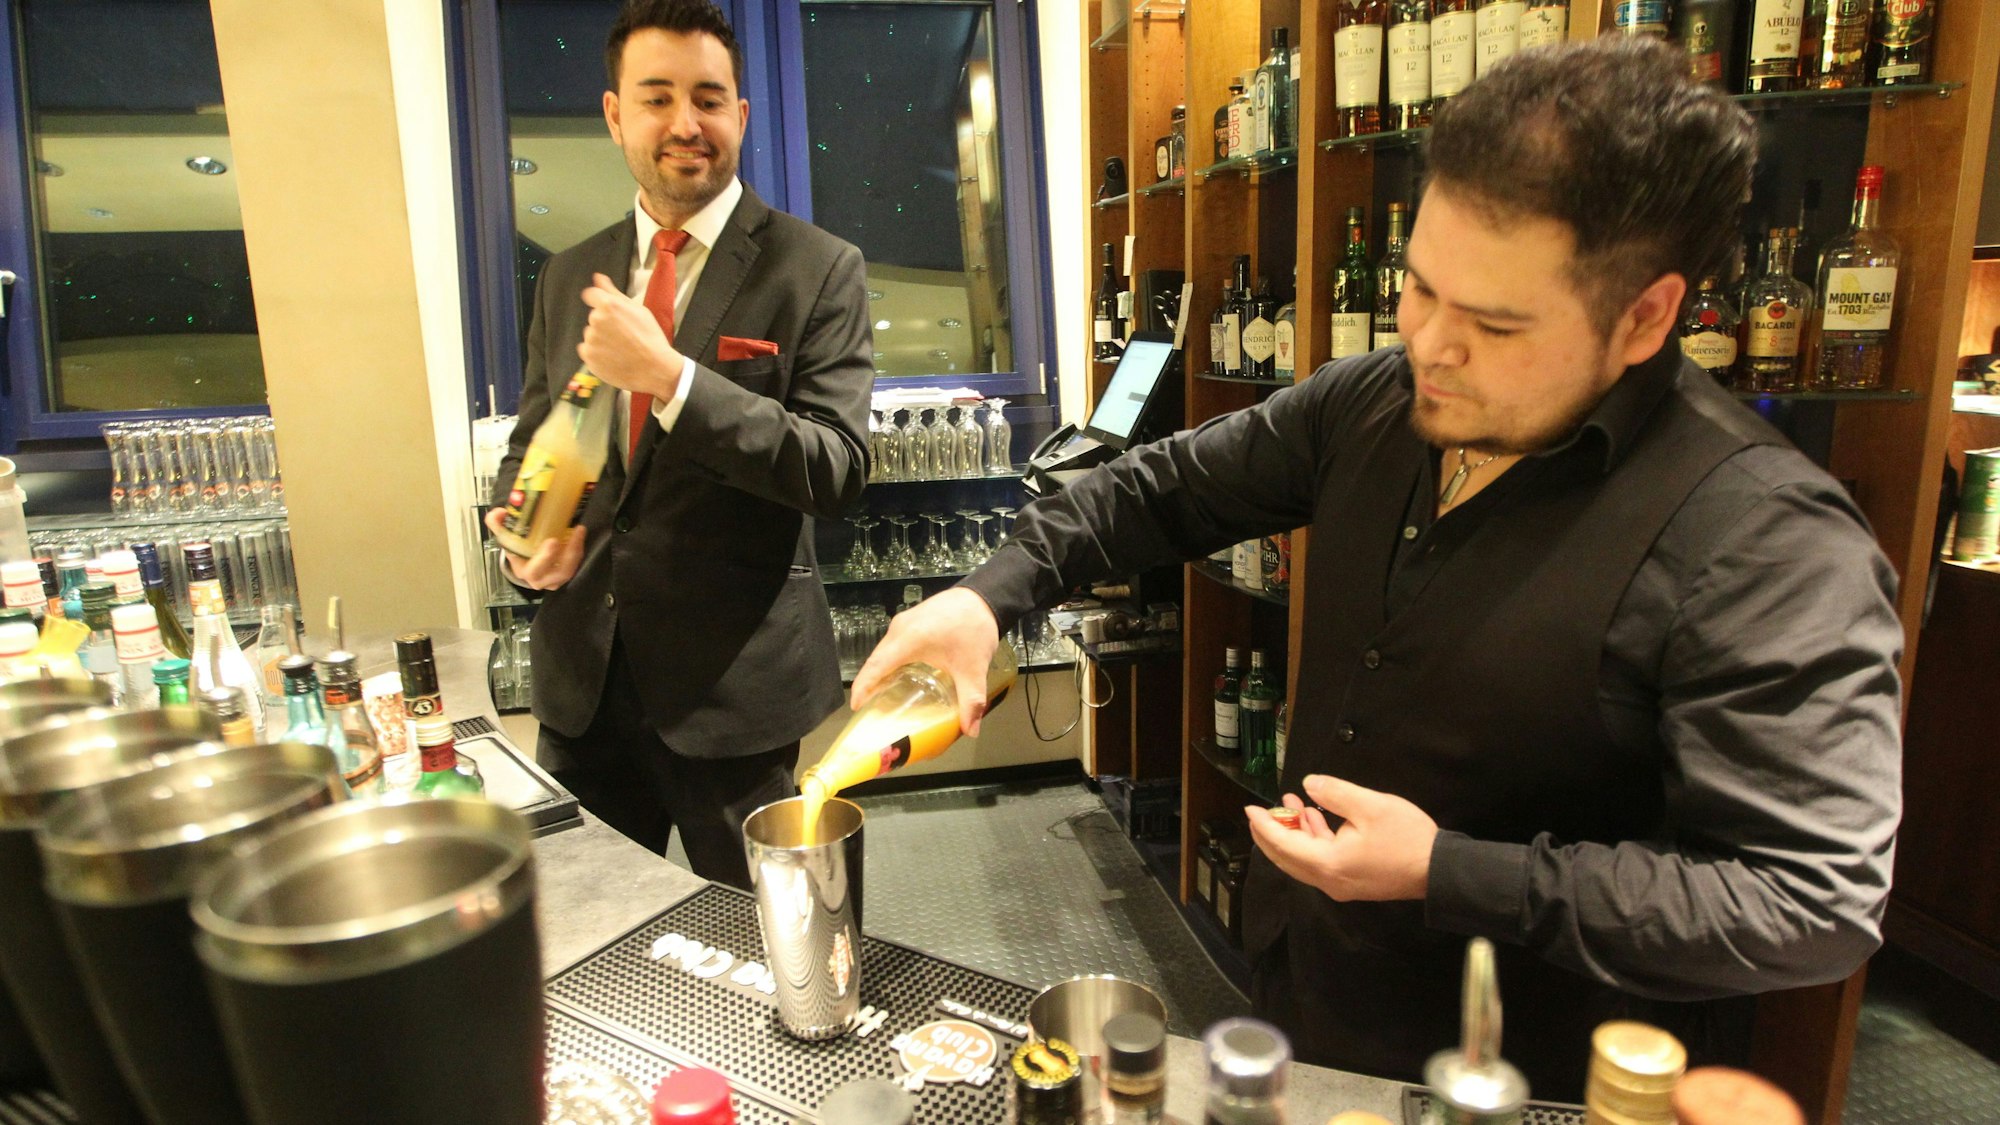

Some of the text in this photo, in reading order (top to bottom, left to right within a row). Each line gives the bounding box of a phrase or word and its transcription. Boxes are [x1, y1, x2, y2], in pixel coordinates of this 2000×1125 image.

[1892, 2, 1920, 15] Club
[1780, 28, 1790, 36] 12
[1898, 26, 1910, 40] 7
[1338, 47, 1375, 58] MACLLAN
[1393, 43, 1431, 55] MAALLAN
[1487, 44, 1499, 55] 12
[1441, 54, 1453, 63] 12
[1406, 61, 1417, 71] 12
[1829, 292, 1892, 304] MOUNT GAY
[1838, 305, 1862, 315] 1703
[1769, 336, 1778, 347] 8
[413, 702, 431, 714] 43
[931, 1025, 989, 1059] Club
[890, 1032, 995, 1087] Havana
